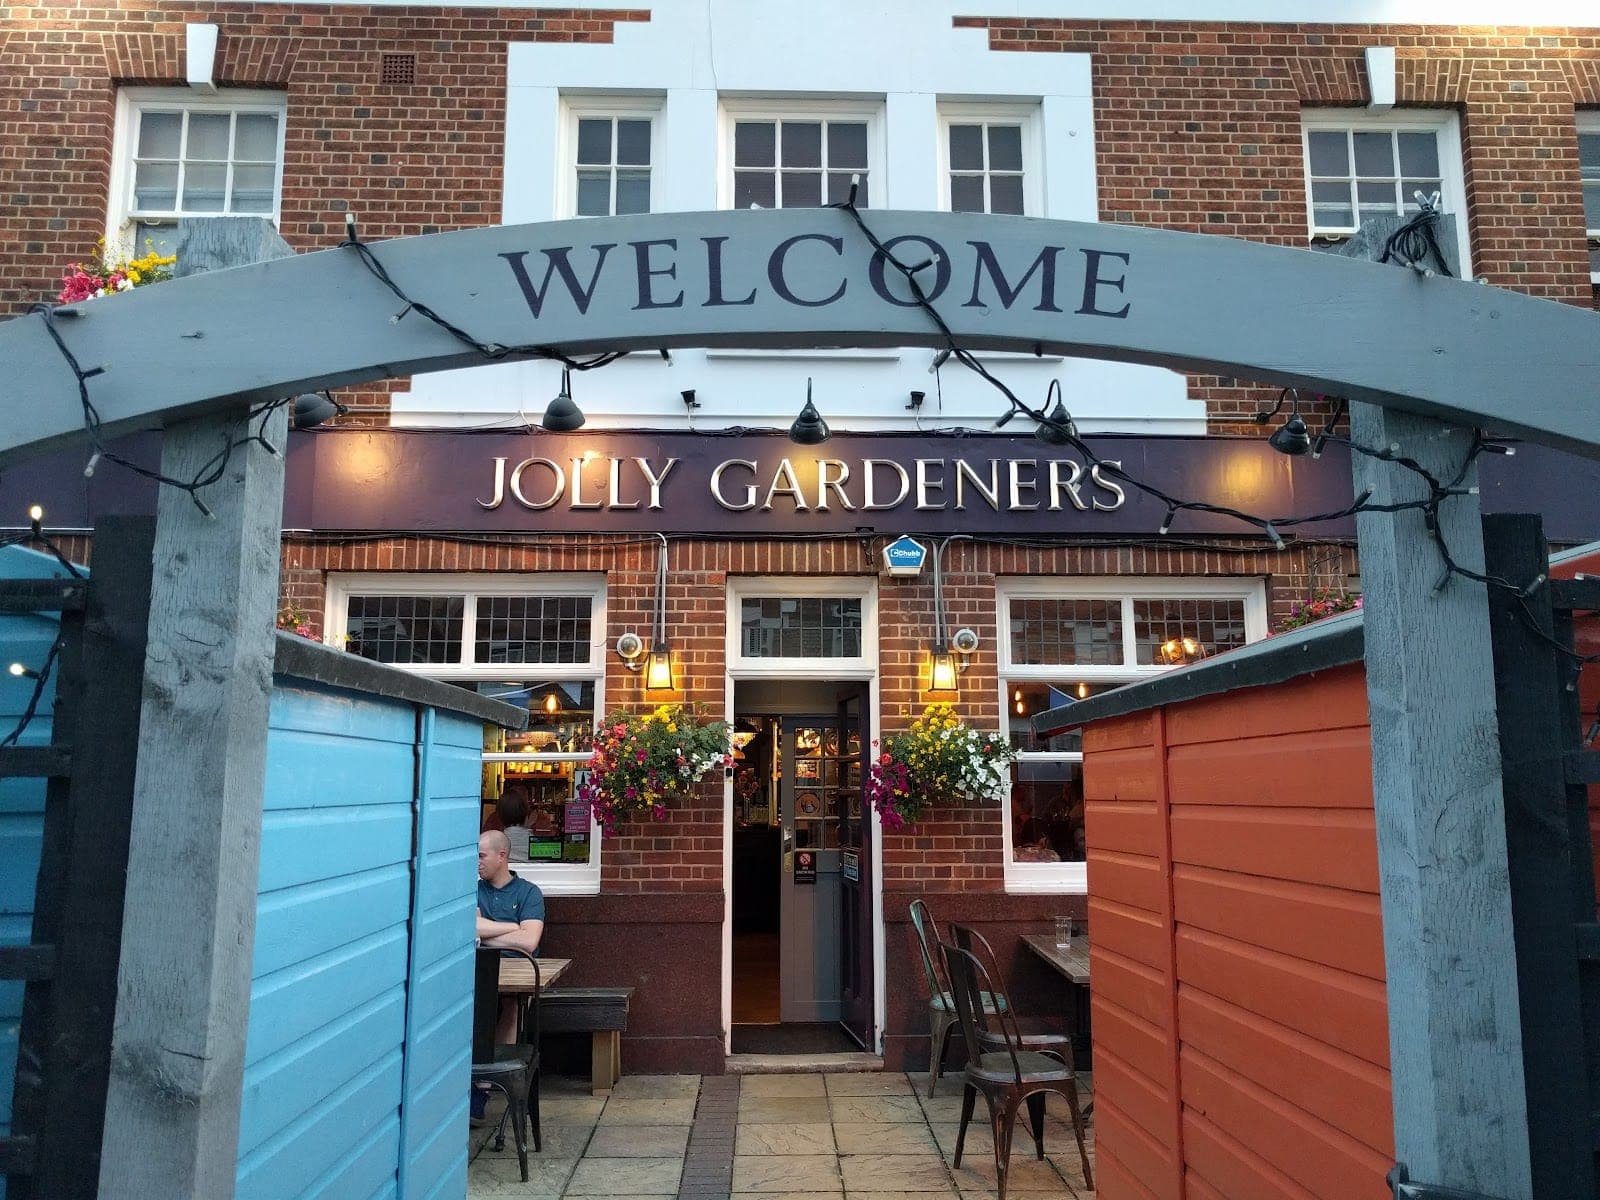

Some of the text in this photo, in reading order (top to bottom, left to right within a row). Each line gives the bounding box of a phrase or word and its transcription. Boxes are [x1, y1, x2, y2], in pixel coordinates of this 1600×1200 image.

[498, 234, 1131, 319] WELCOME
[476, 456, 1126, 512] JOLLY GARDENERS
[898, 549, 921, 557] Chubb
